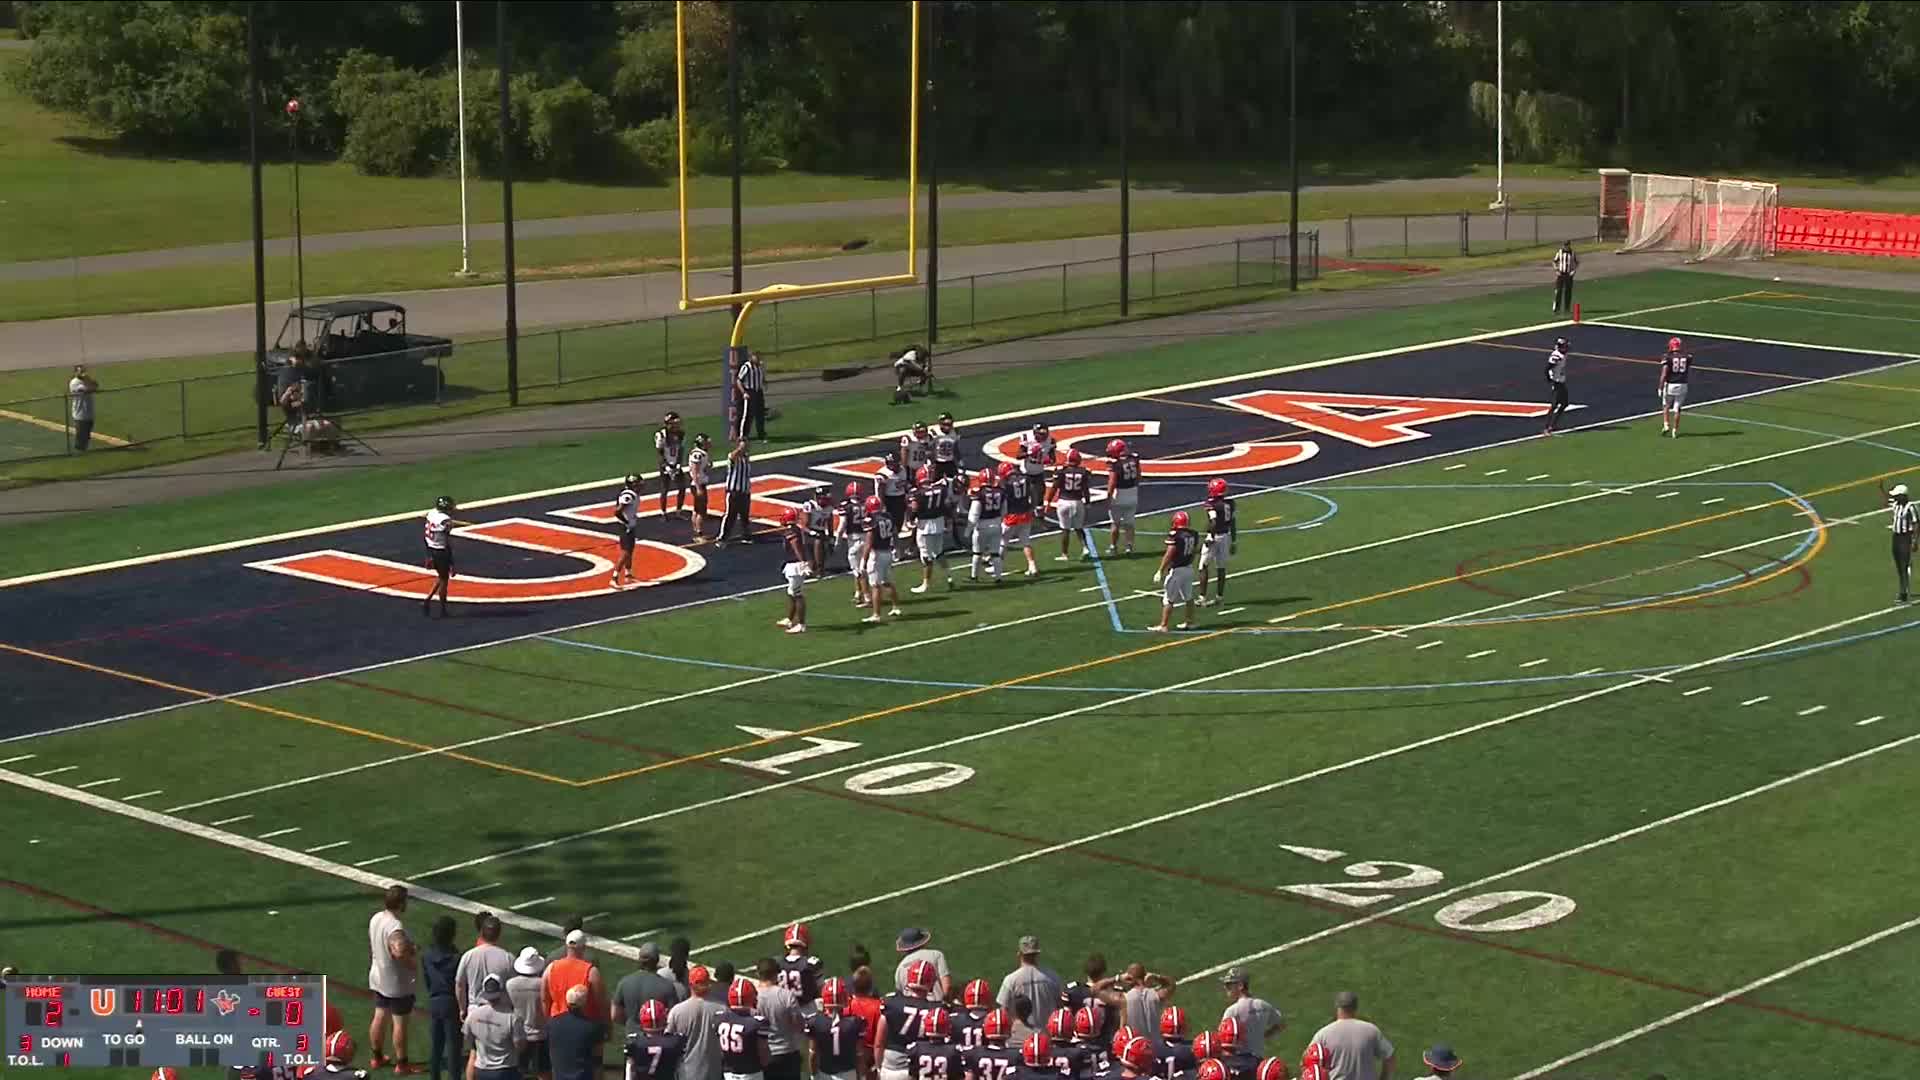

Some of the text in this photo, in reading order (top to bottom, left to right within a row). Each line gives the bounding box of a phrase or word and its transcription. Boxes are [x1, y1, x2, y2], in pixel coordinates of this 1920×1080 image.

[1064, 473, 1082, 491] 52
[924, 489, 942, 510] 77
[984, 492, 1002, 511] 53
[879, 519, 894, 539] 82
[830, 1026, 842, 1057] 1
[647, 1046, 663, 1075] 7
[918, 1055, 948, 1080] 23
[978, 1058, 1009, 1080] 37
